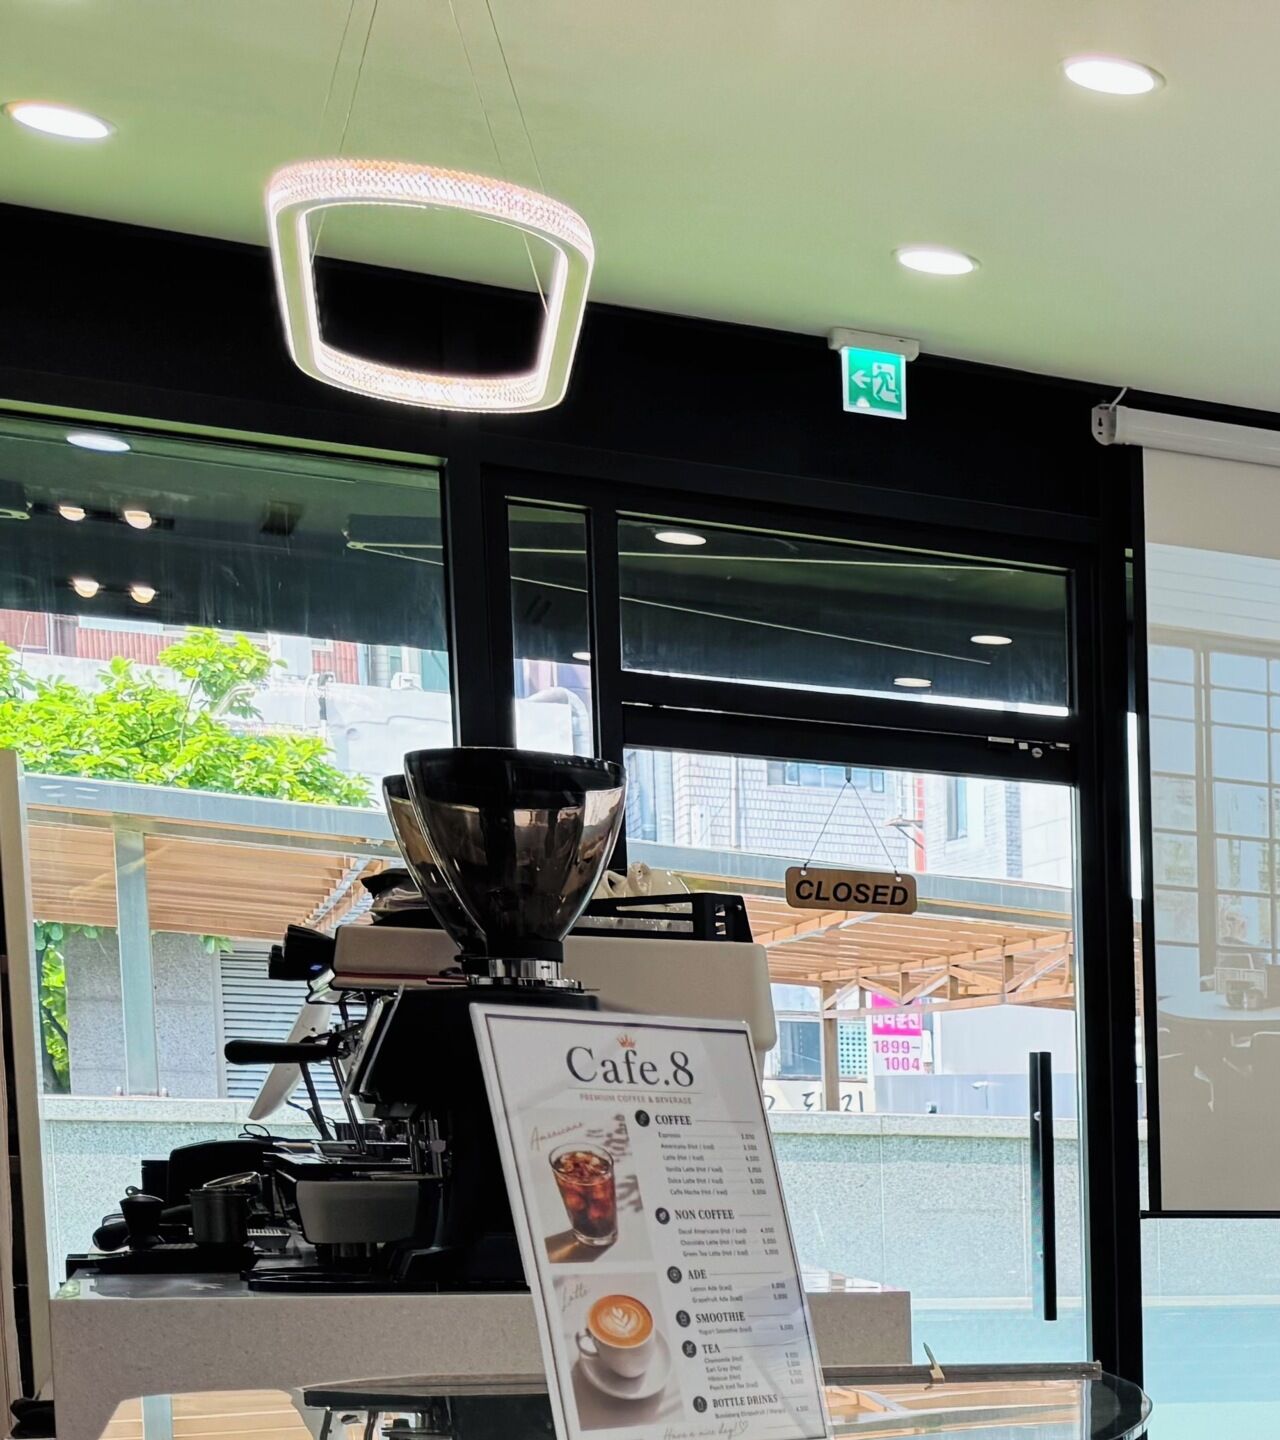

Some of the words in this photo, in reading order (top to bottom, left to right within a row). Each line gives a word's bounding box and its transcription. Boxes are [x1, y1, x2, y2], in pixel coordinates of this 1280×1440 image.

[795, 880, 908, 906] CLOSED
[566, 1046, 694, 1087] Cafe.8
[884, 1057, 920, 1071] 1004
[655, 1114, 692, 1125] COFFEE
[674, 1209, 696, 1220] NON
[698, 1209, 735, 1220] COFFEE
[688, 1269, 707, 1280] ADE
[695, 1311, 746, 1324] SMOOTHIE
[702, 1344, 721, 1354] TEA
[712, 1397, 745, 1408] BOTTLE
[747, 1394, 778, 1405] DRINKS
